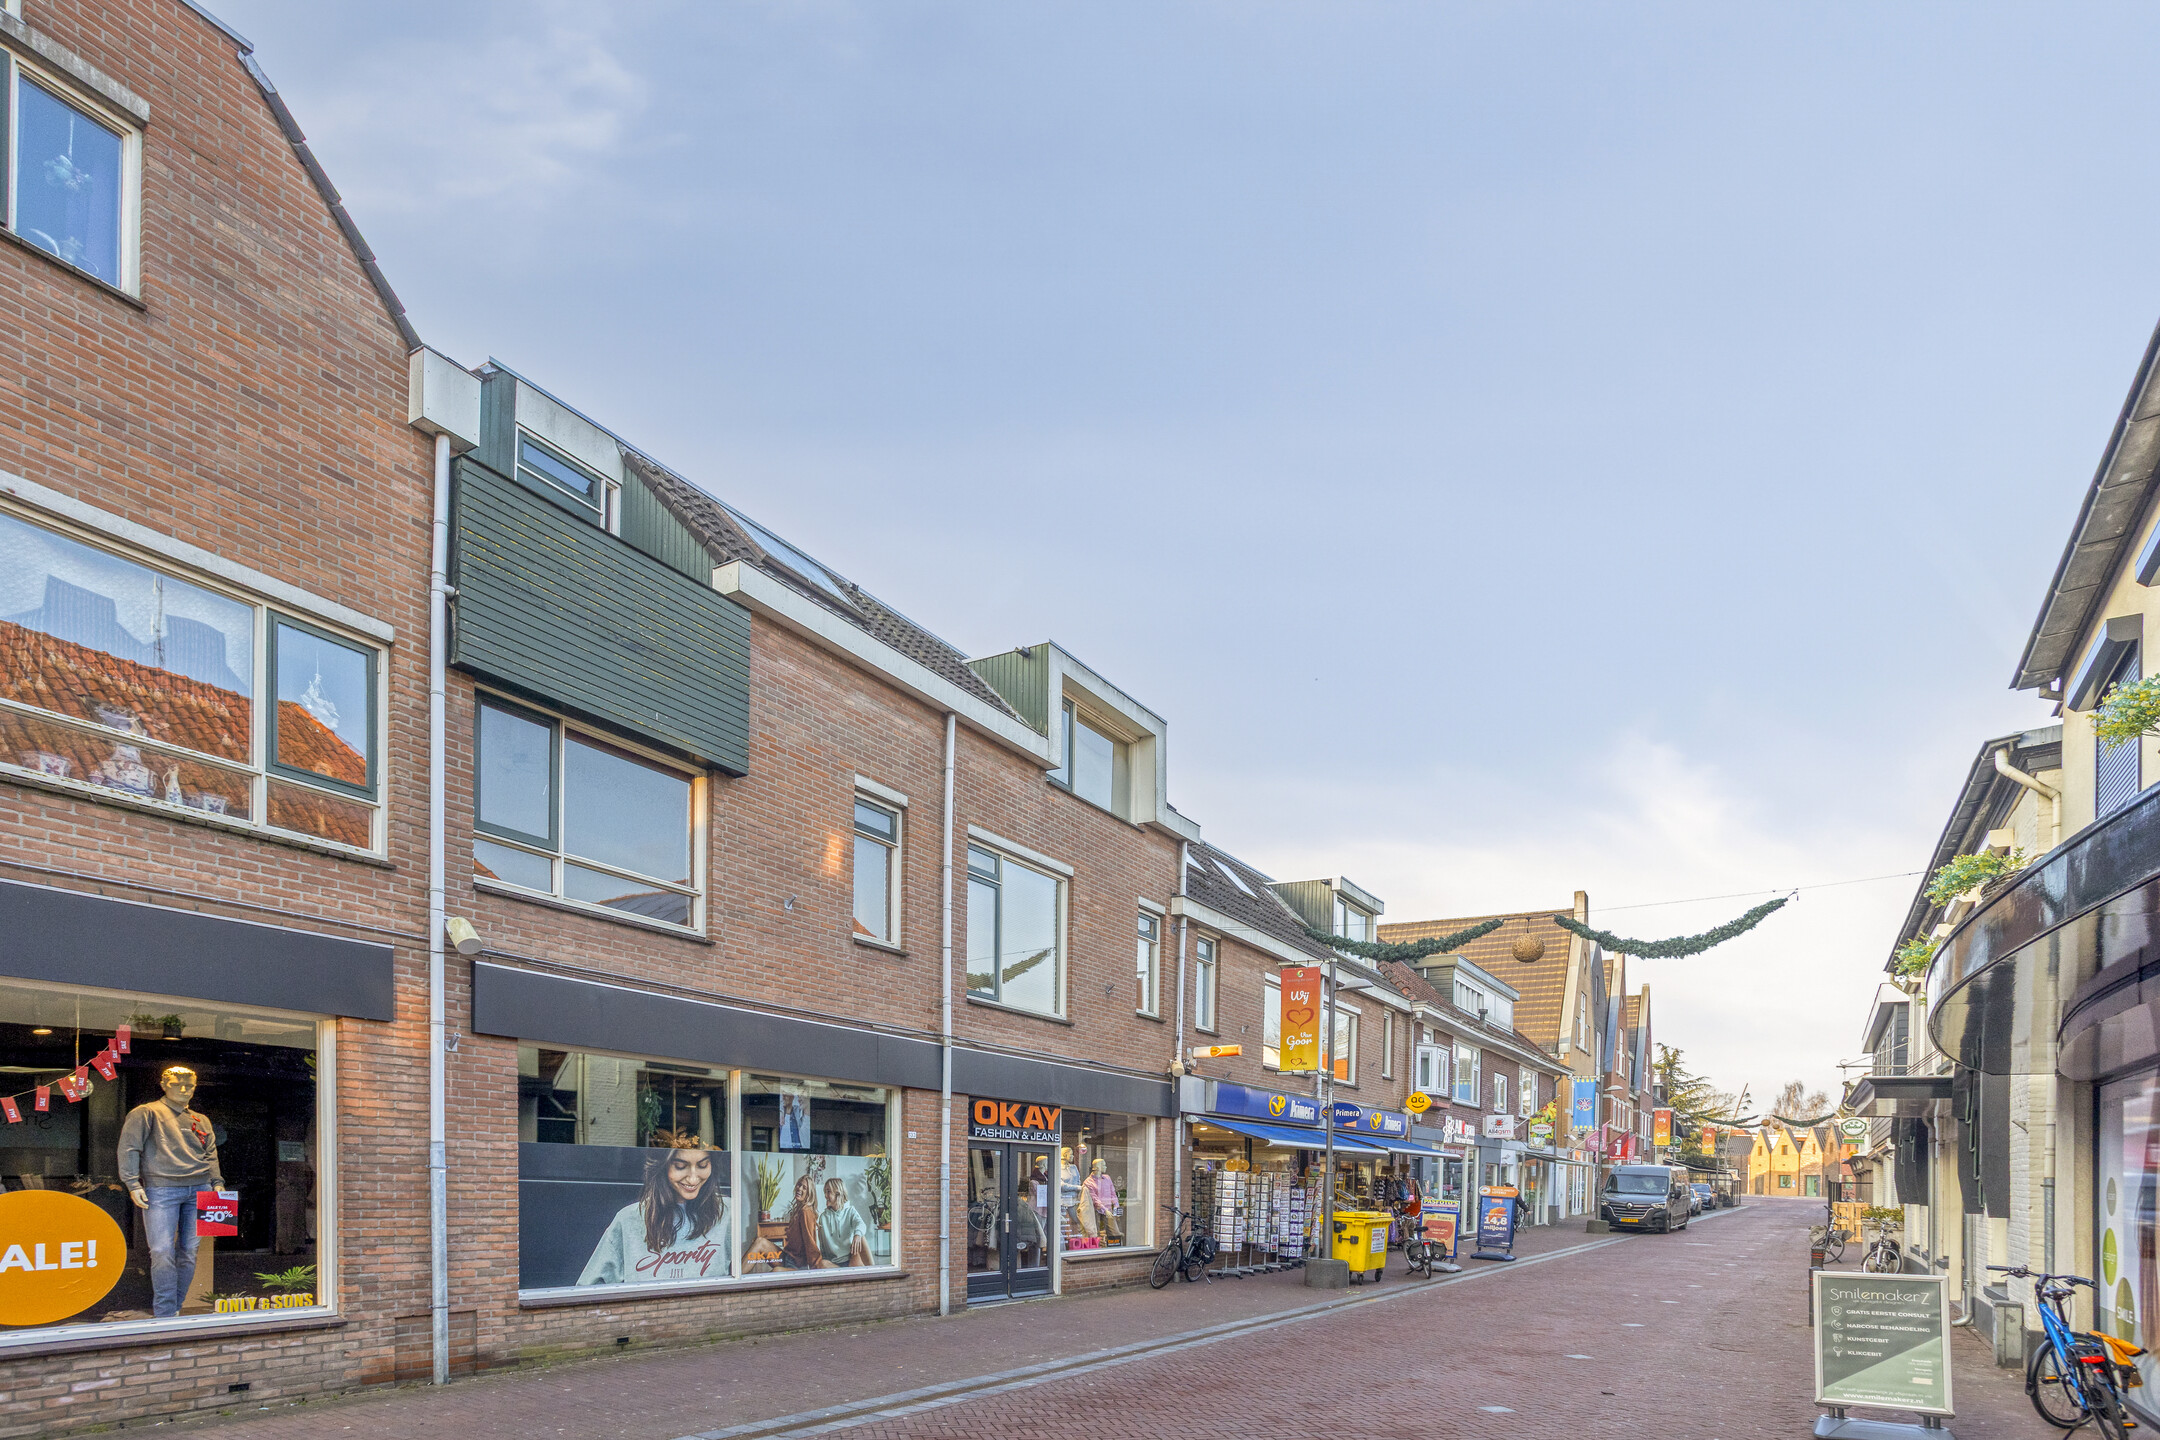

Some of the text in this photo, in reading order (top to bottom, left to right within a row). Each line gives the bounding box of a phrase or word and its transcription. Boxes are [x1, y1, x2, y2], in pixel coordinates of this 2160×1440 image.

[1290, 990, 1310, 1005] Wij
[1286, 1035, 1312, 1051] Goor
[974, 1100, 1061, 1131] OKAY
[1289, 1100, 1315, 1120] Primera
[1335, 1109, 1360, 1117] Primera
[975, 1127, 1060, 1142] FASHION & JEANS
[200, 1210, 234, 1223] -50%
[1484, 1216, 1508, 1225] 14,8
[1070, 1236, 1102, 1250] ONLY
[635, 1240, 721, 1278] Sporty
[747, 1250, 783, 1260] OKAY
[216, 1293, 314, 1314] ONLY & SONS
[2116, 1305, 2134, 1325] SMILE
[1880, 1325, 1931, 1333] BEHANDELING
[1847, 1336, 1889, 1344] KUNSTGEBIT
[1843, 1393, 1924, 1405] www.smilemakerz.nl
